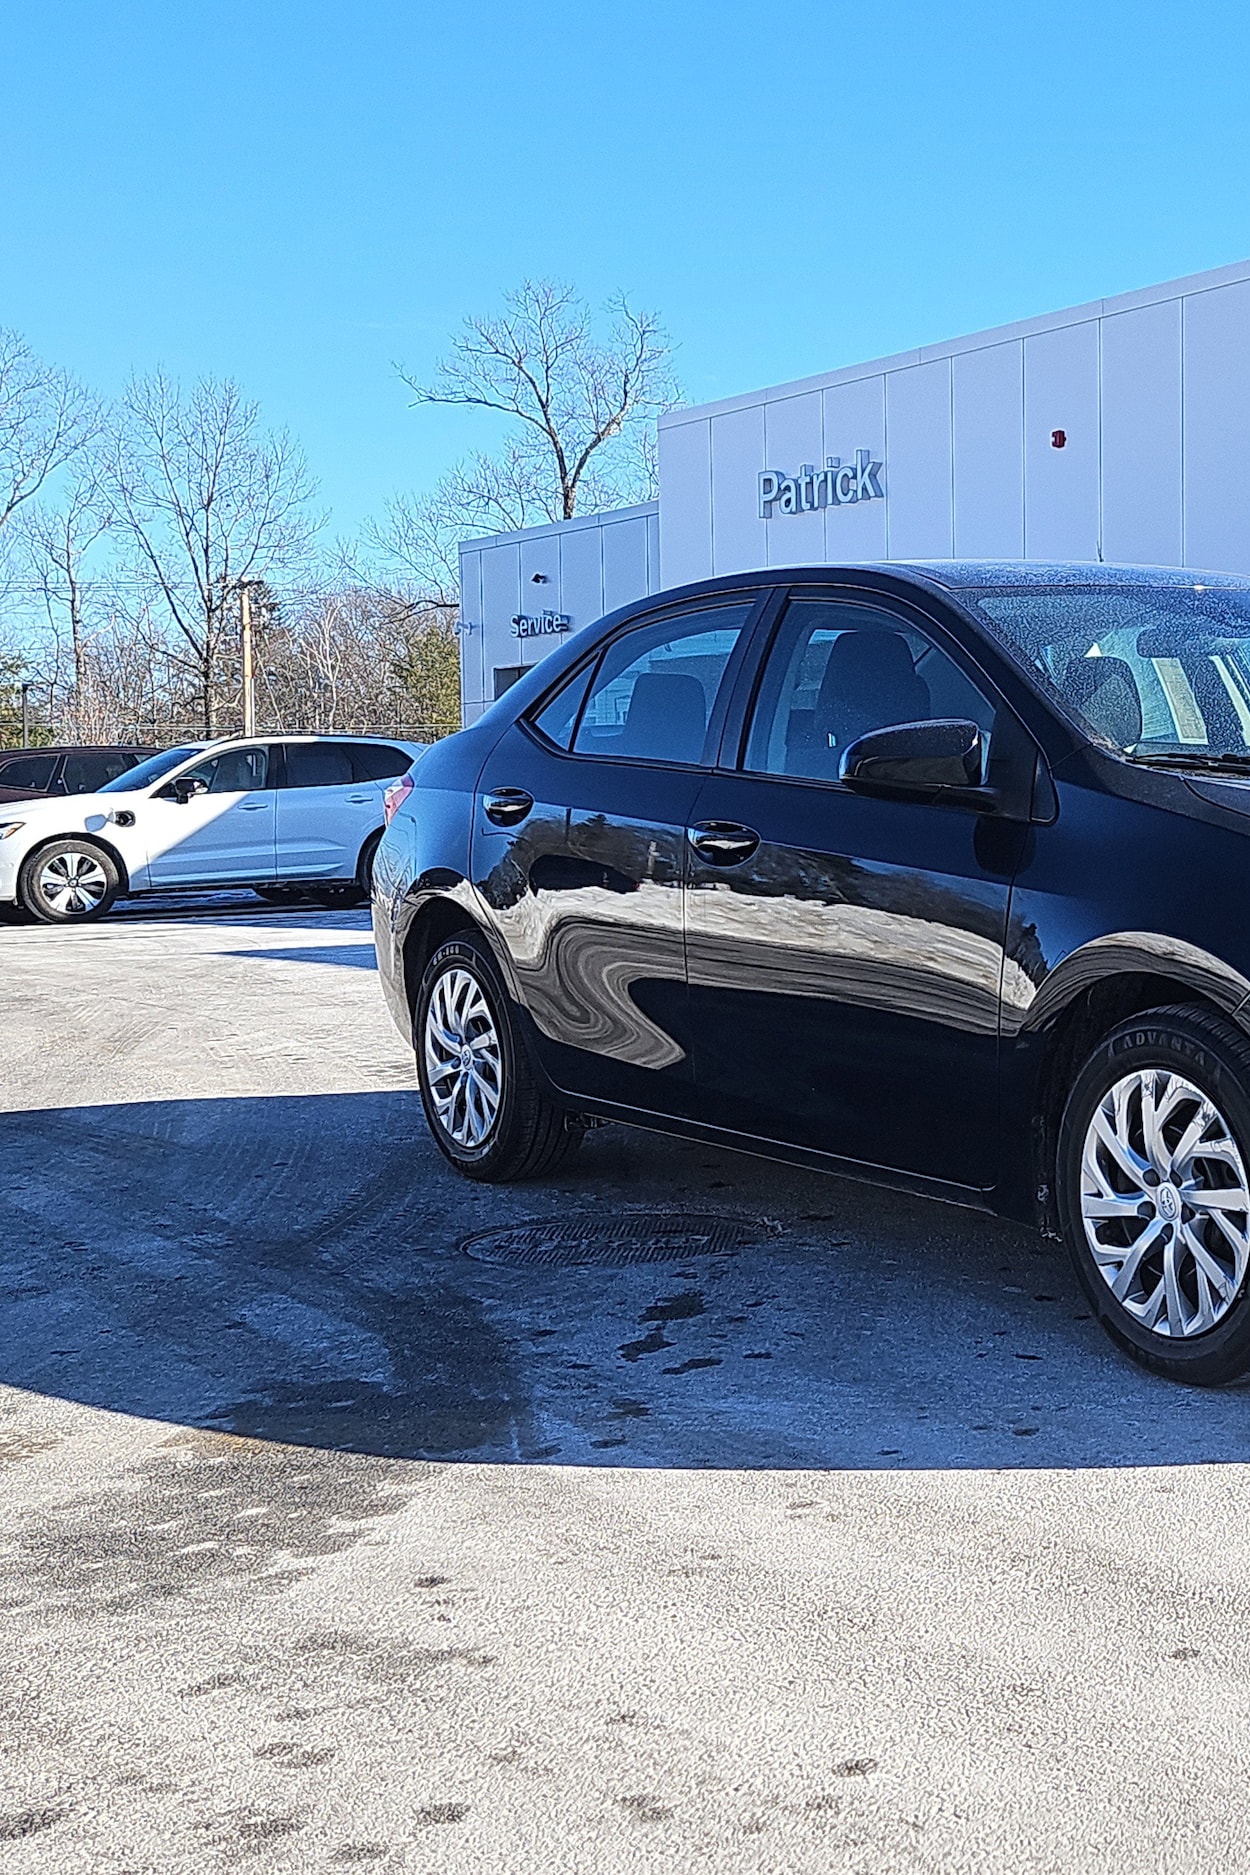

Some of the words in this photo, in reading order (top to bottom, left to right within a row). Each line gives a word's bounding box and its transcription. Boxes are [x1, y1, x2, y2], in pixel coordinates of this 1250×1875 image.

[757, 449, 884, 519] Patrick
[510, 609, 567, 638] Service
[1122, 1031, 1206, 1067] ADVANTA
